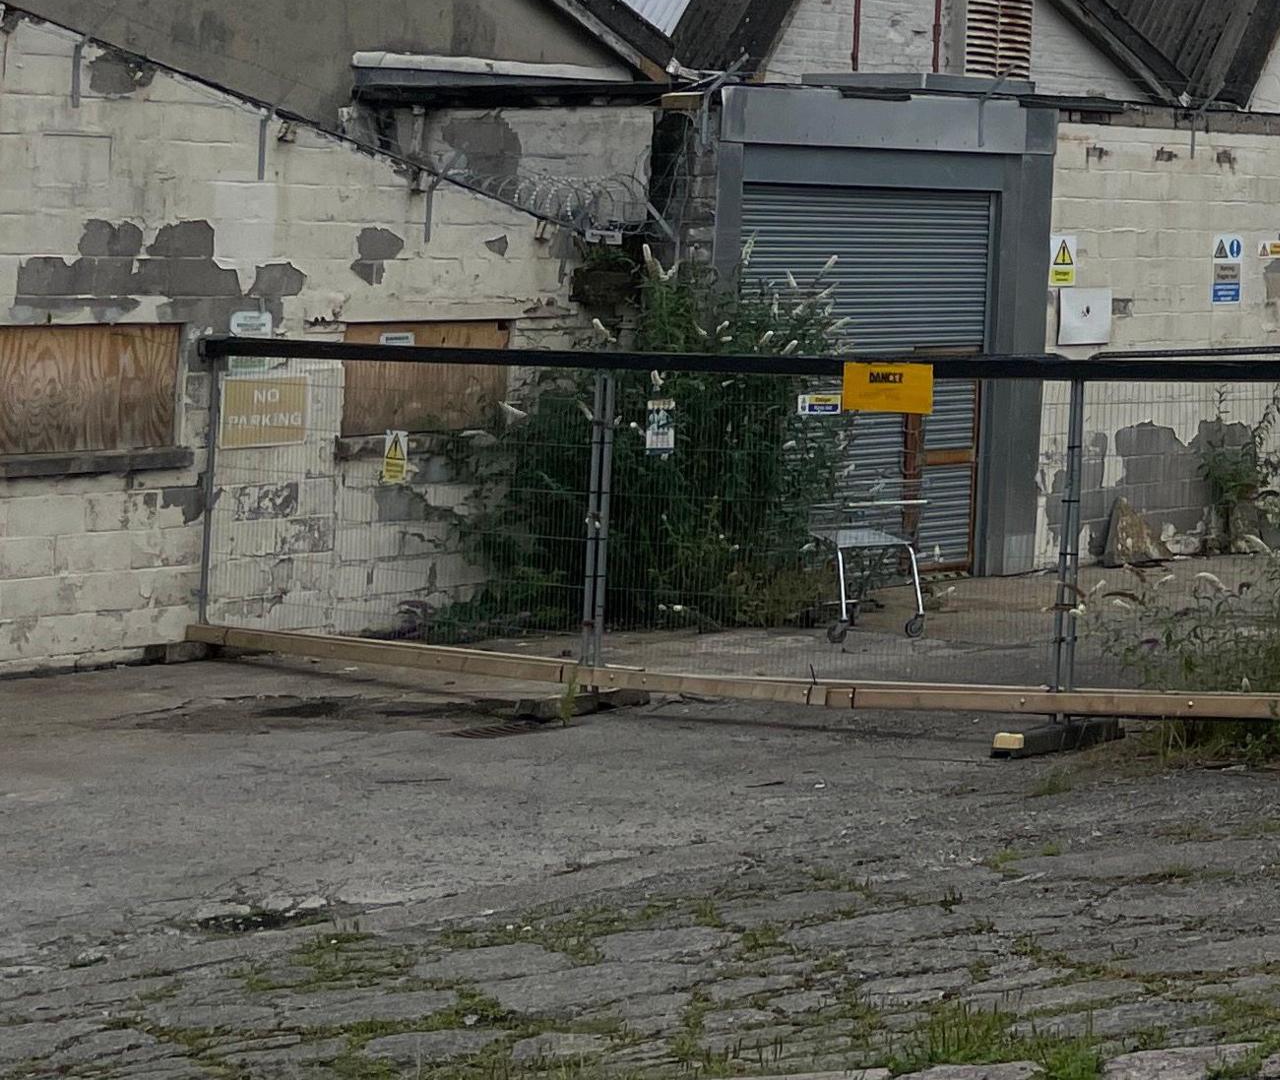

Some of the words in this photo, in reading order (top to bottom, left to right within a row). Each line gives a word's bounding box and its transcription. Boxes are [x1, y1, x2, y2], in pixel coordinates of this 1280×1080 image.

[868, 371, 904, 384] DANGER
[253, 388, 280, 404] NO
[228, 411, 302, 427] PARKING
